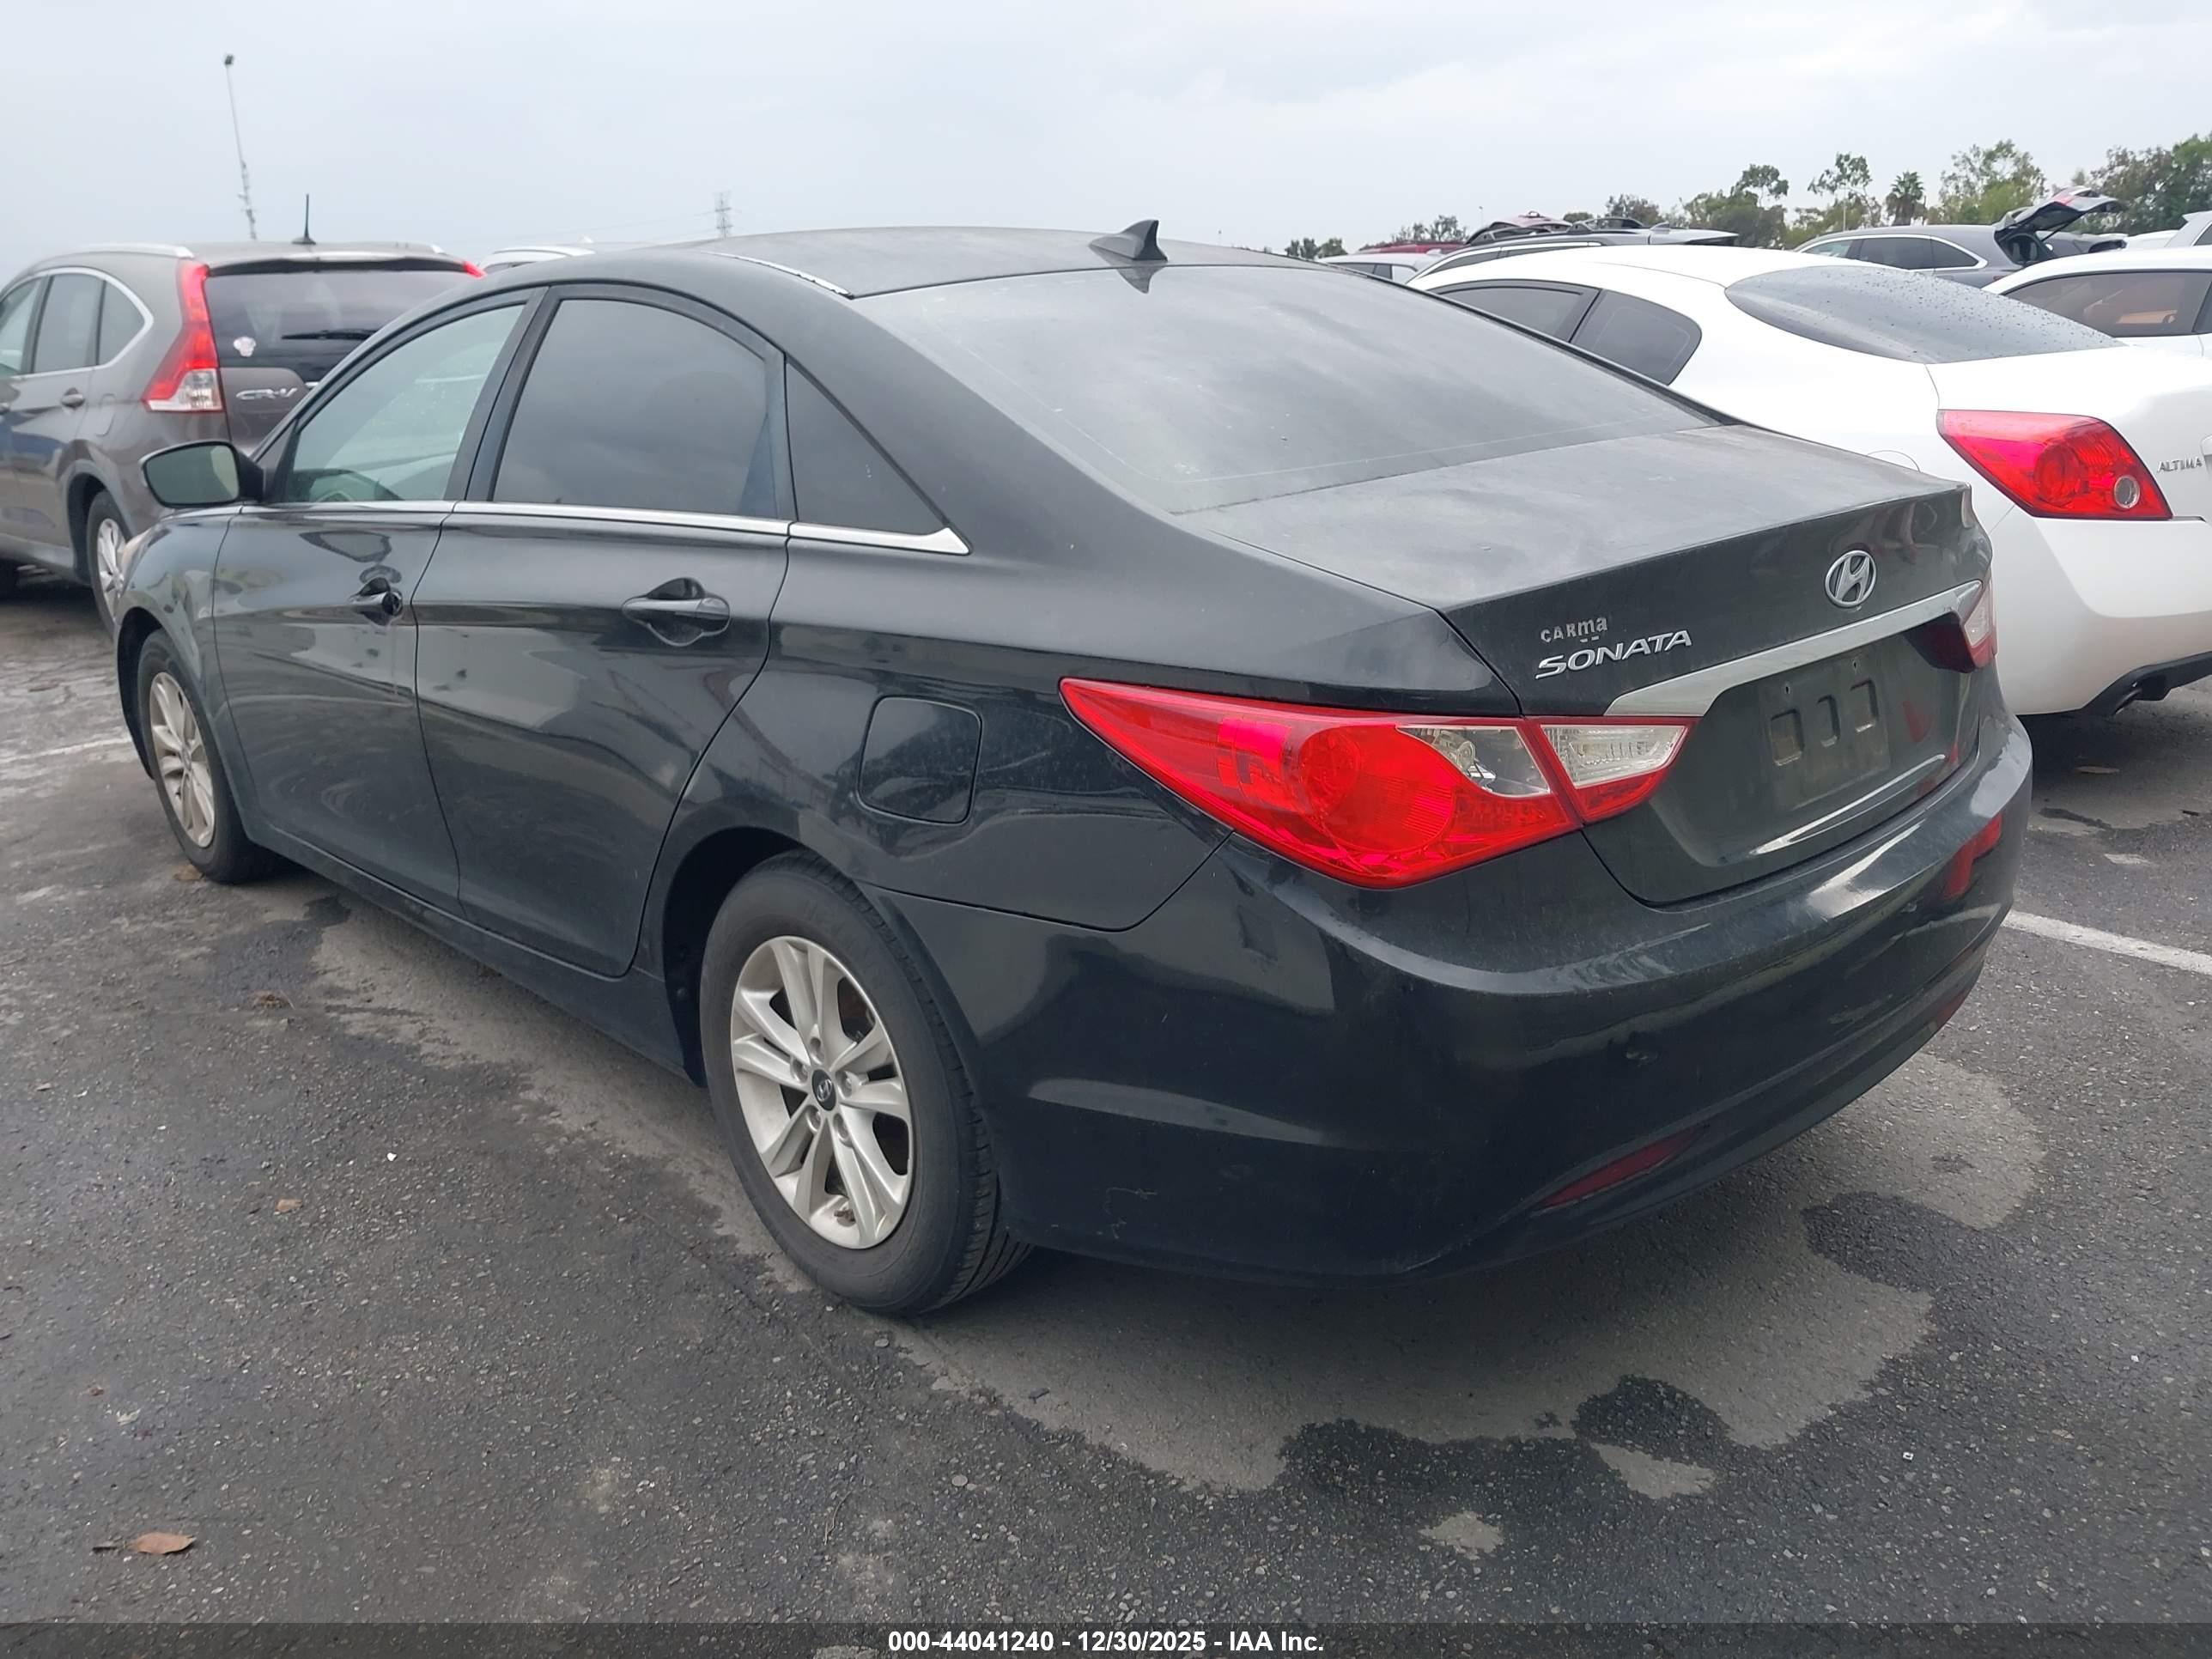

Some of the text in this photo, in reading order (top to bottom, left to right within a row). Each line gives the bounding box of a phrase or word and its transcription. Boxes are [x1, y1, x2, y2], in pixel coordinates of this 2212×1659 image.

[236, 387, 298, 401] CR-V
[2157, 456, 2203, 473] ALTIMA
[1534, 629, 1692, 679] SONATA
